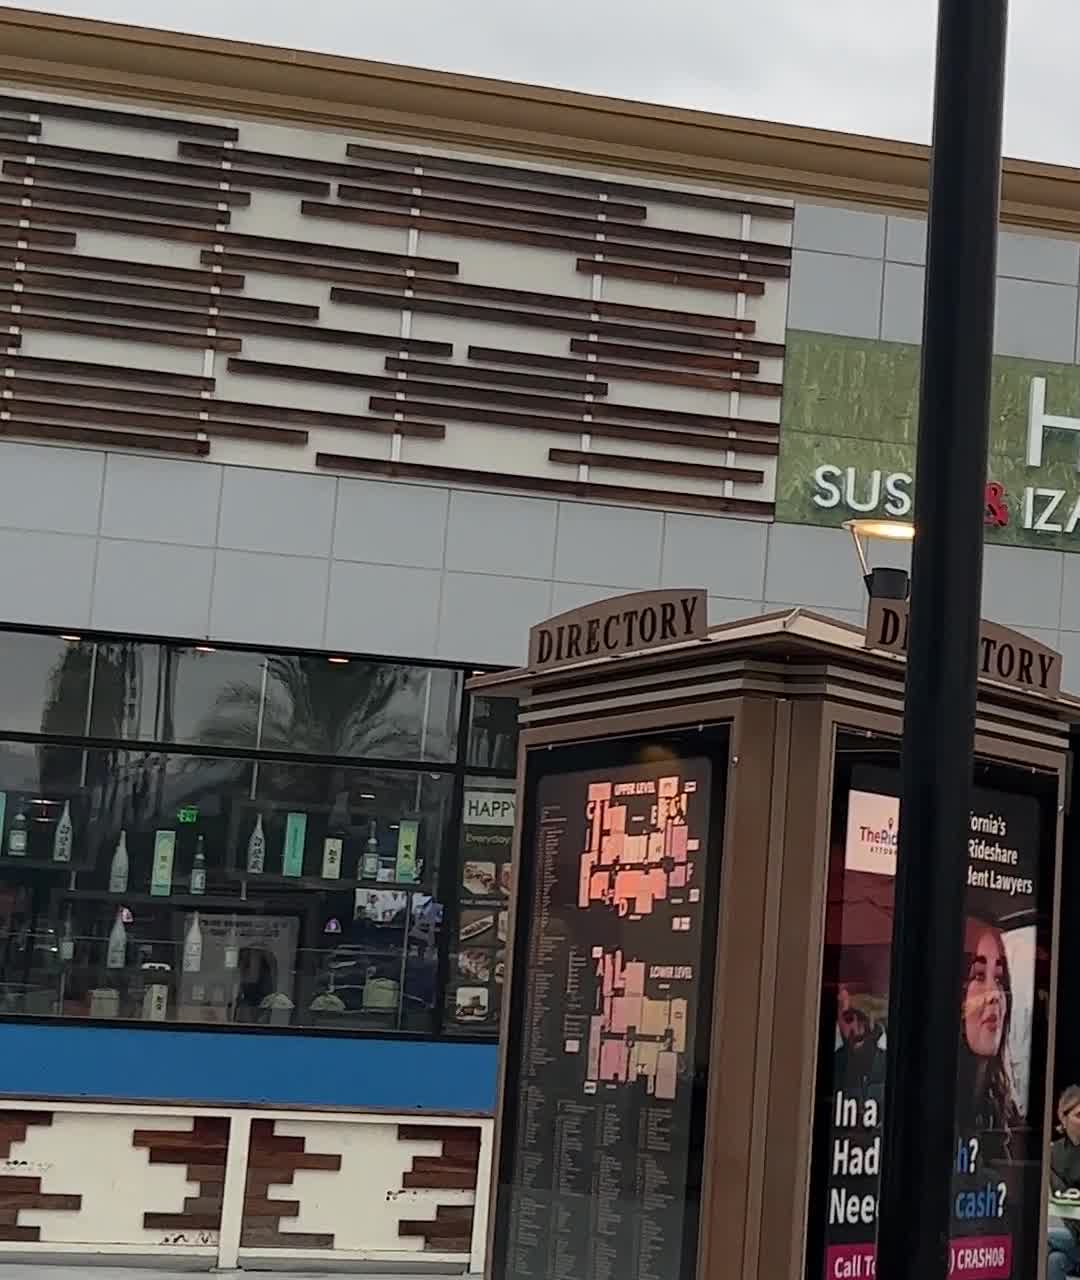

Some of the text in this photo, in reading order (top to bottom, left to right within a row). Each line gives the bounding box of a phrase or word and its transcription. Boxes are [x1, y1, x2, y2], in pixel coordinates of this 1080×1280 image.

[813, 464, 913, 516] SUS
[983, 480, 1009, 528] &
[536, 596, 698, 665] DIRECTORY
[468, 799, 515, 818] HAPP
[860, 826, 898, 847] TheRid
[990, 870, 1033, 896] Lawyers
[835, 1090, 878, 1127] In a
[832, 1137, 880, 1176] Had
[955, 1182, 1007, 1219] cash?
[834, 1255, 861, 1279] Call
